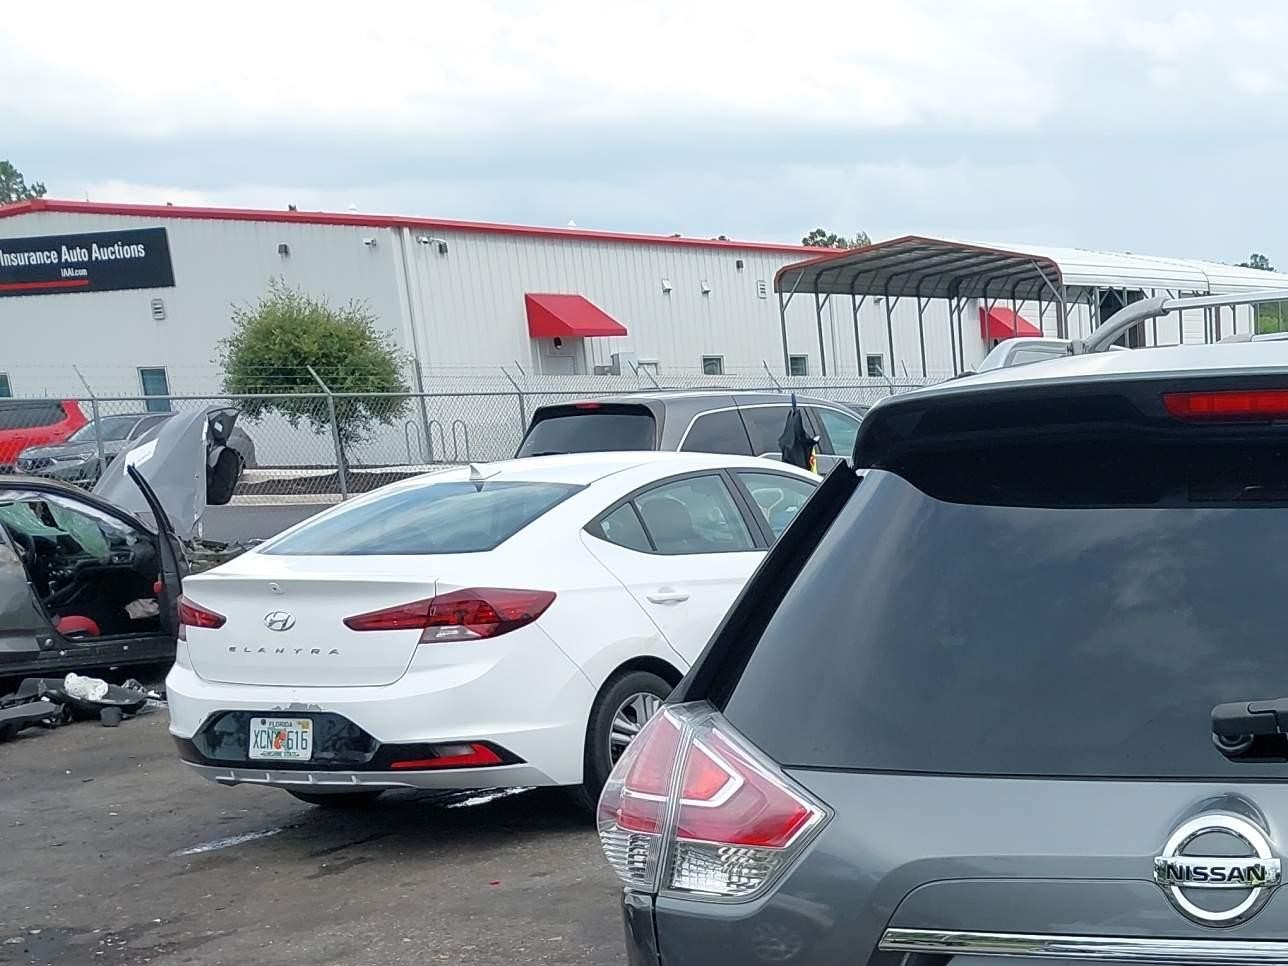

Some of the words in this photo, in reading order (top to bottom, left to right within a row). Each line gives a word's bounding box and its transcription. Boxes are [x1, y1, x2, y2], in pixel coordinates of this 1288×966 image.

[0, 249, 58, 266] Insurance
[61, 245, 89, 263] Auto
[92, 241, 145, 261] Auctions
[228, 646, 340, 655] ELANTRA
[1166, 863, 1266, 882] NISSAN
